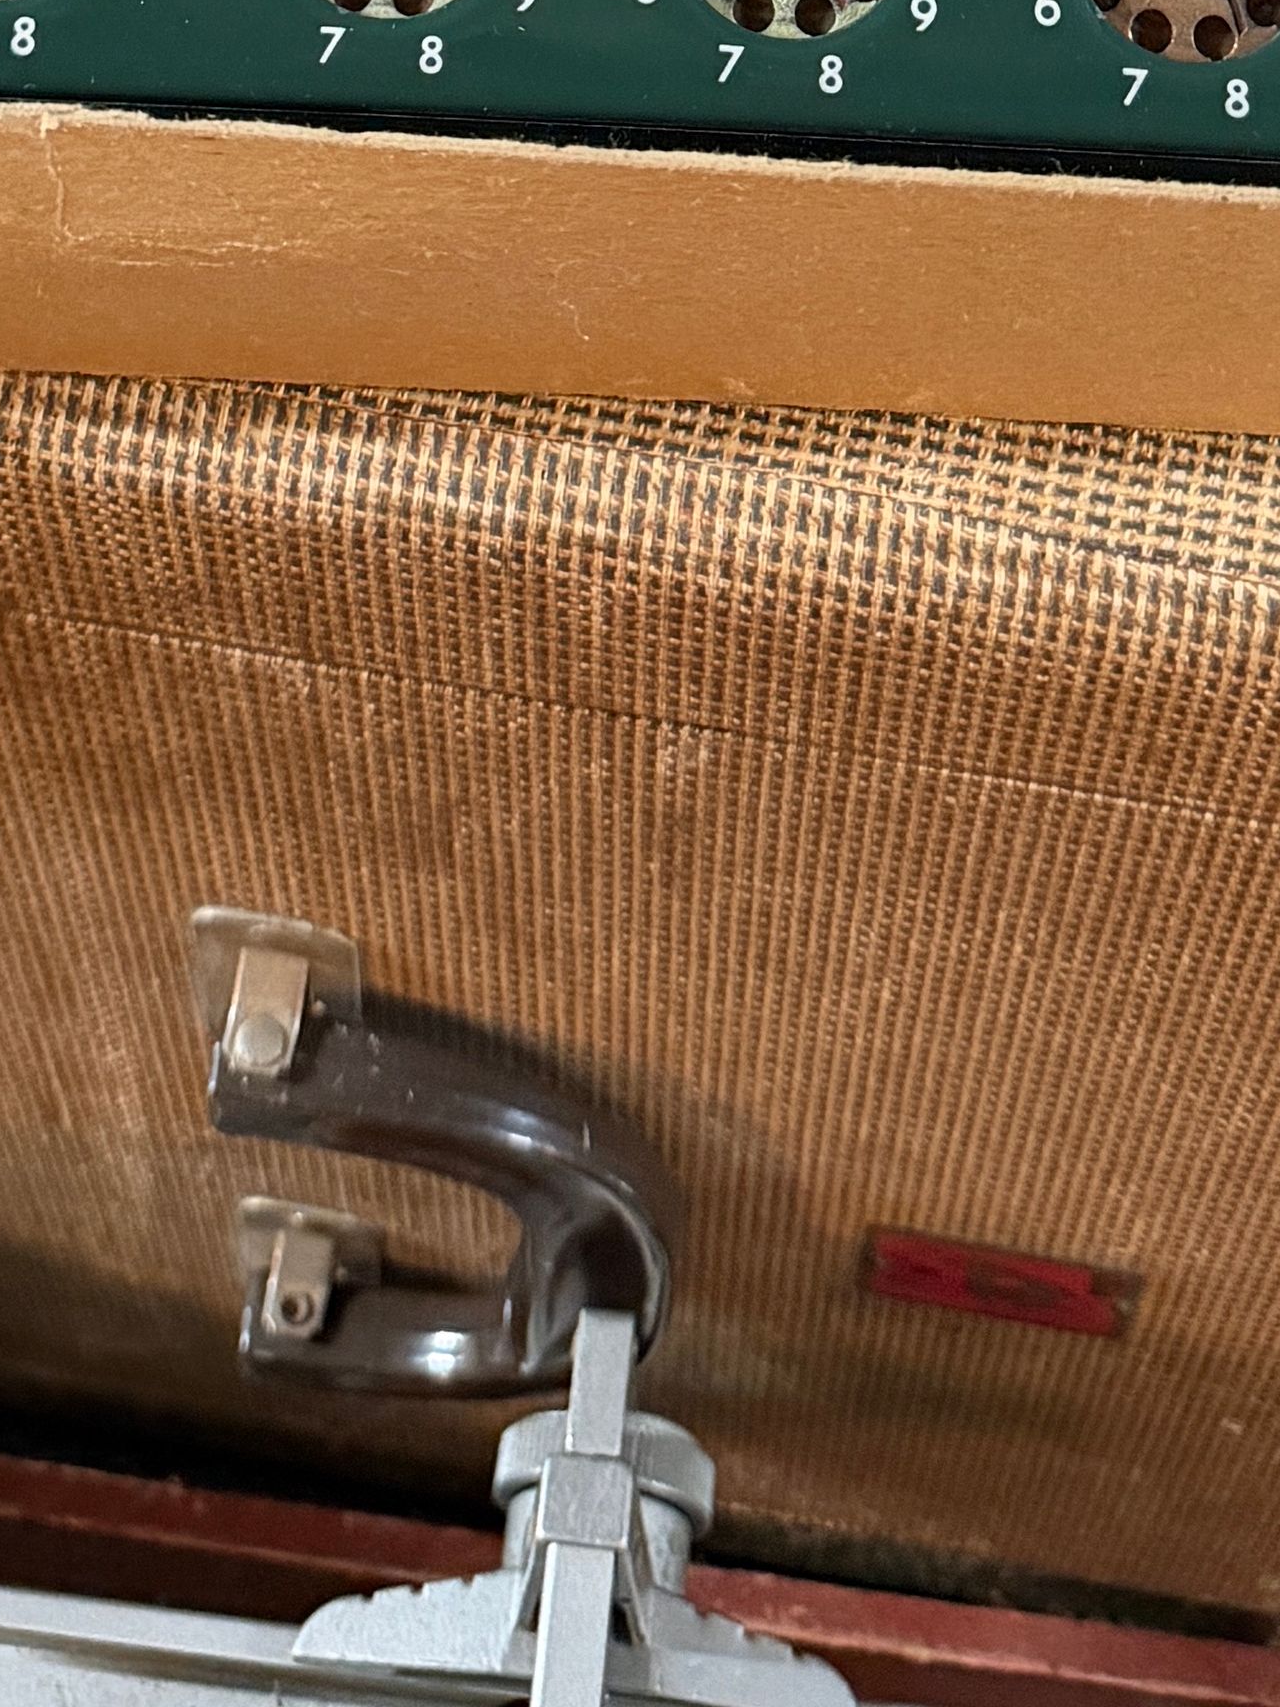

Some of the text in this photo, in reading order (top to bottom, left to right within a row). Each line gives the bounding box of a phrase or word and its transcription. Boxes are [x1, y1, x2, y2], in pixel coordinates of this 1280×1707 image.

[10, 16, 36, 56] 8
[319, 26, 346, 64] 7
[419, 35, 443, 75] 8
[718, 44, 745, 83] 7
[818, 54, 843, 94] 8
[1122, 67, 1149, 106] 7
[1224, 78, 1250, 119] 8
